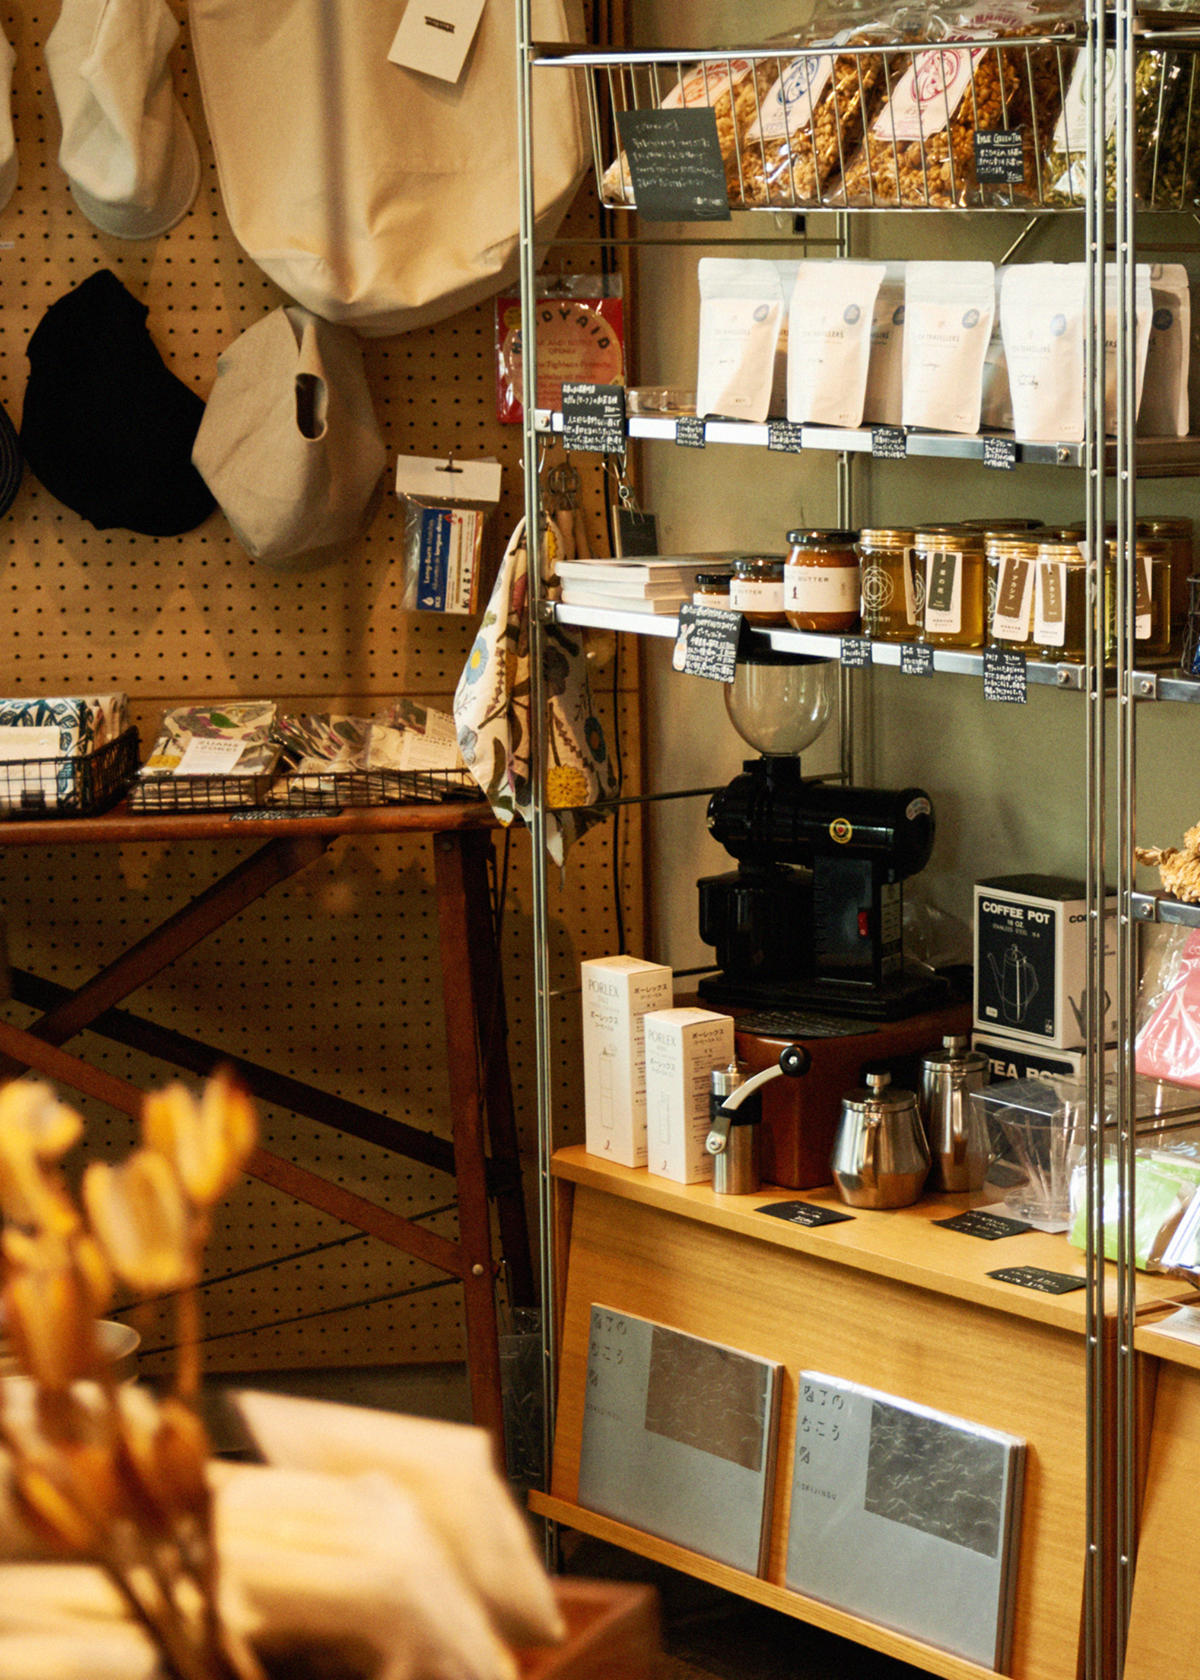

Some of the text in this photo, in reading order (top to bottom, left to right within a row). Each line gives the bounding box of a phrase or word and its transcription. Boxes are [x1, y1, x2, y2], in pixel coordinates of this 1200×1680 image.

[982, 900, 1050, 925] COFFEE POT
[588, 979, 619, 998] PORLEX
[634, 983, 668, 995] ポーレックス
[692, 1027, 725, 1040] ポーレックス
[988, 1058, 1019, 1080] TEA
